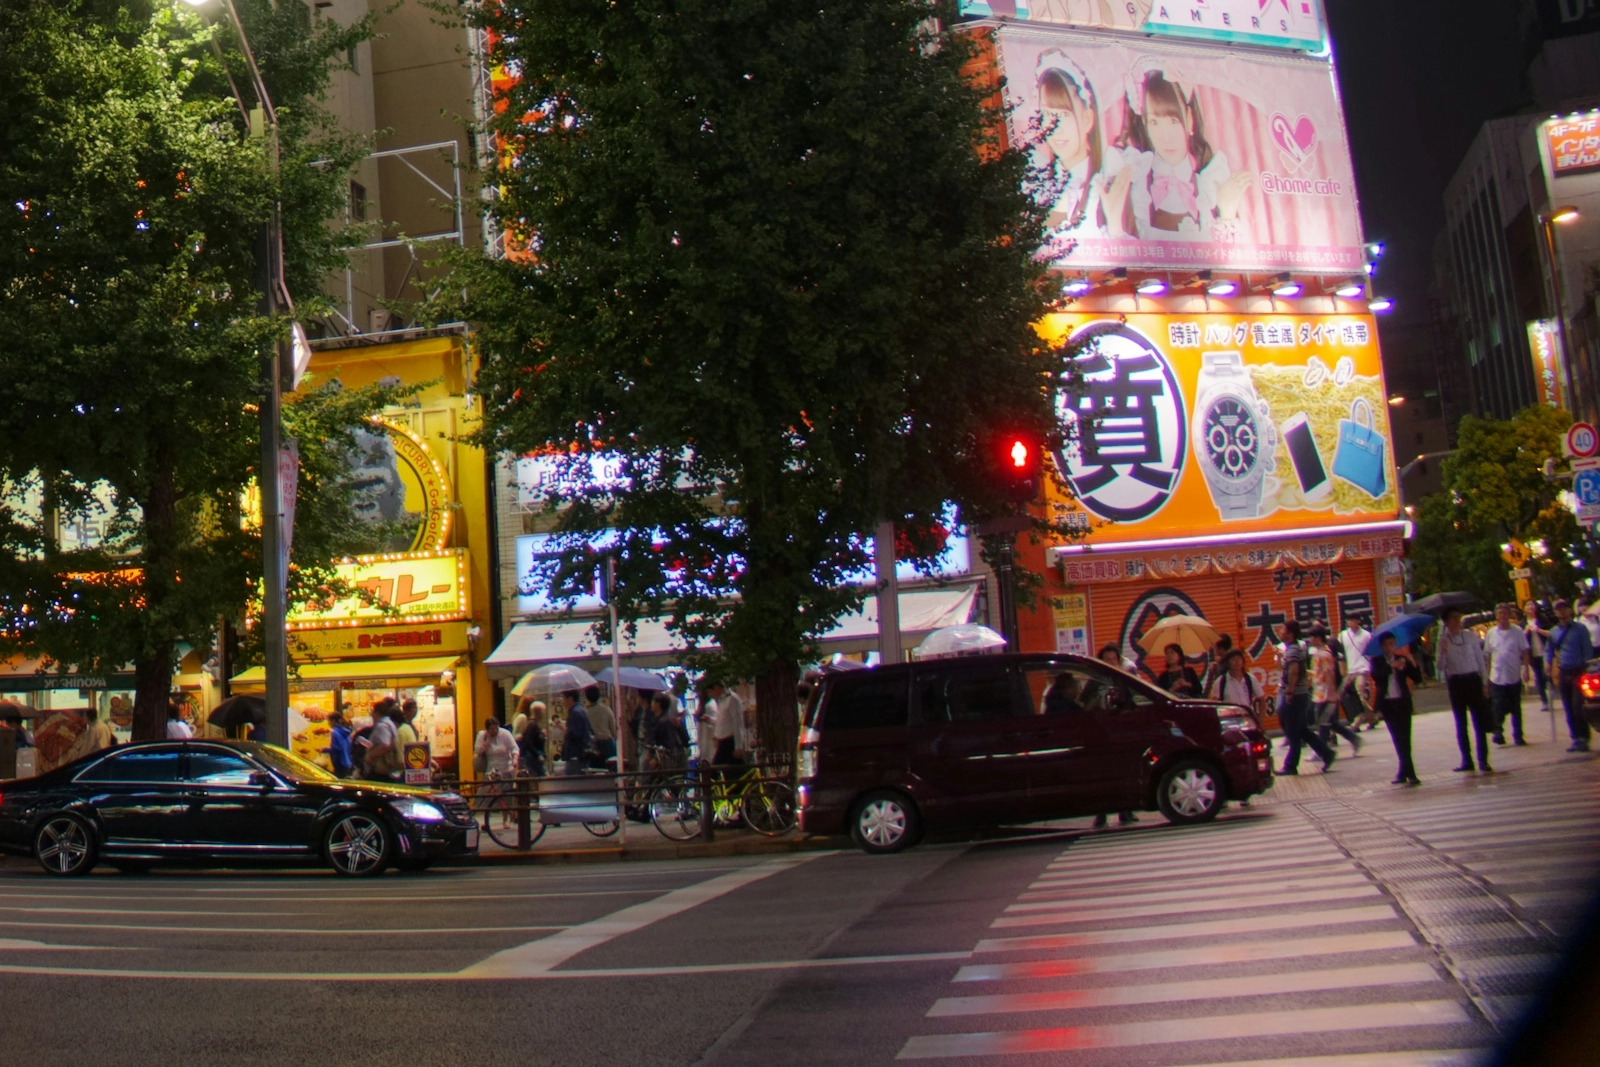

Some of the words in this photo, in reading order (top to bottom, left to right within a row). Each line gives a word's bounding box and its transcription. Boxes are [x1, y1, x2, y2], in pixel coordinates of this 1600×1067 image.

[1126, 2, 1288, 31] GAMERS
[1261, 171, 1312, 195] @home
[1315, 177, 1342, 196] cafe
[1170, 323, 1199, 346] 時計
[1205, 324, 1248, 346] バッグ
[1252, 324, 1294, 345] 貴金属
[1299, 324, 1337, 345] ダイヤ
[1575, 437, 1591, 448] 40
[1580, 479, 1593, 501] P
[1066, 560, 1121, 580] 高価買取
[1273, 565, 1343, 593] チケット
